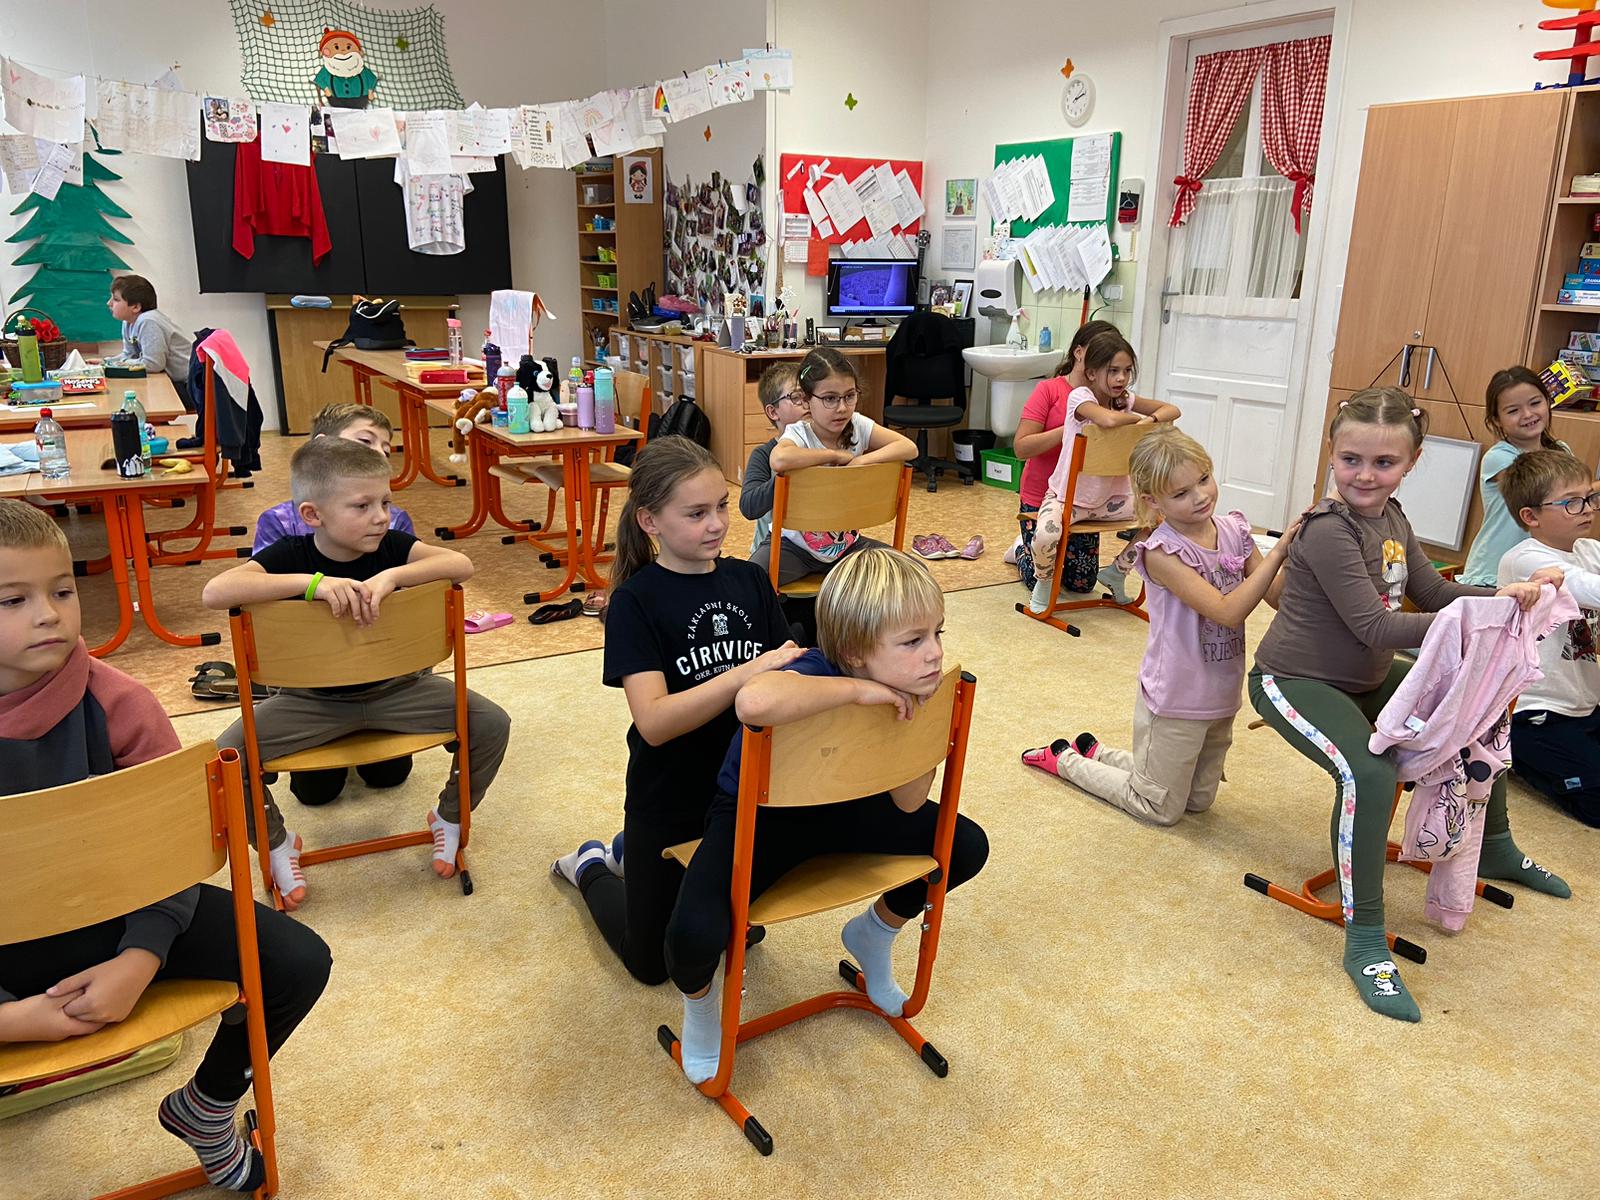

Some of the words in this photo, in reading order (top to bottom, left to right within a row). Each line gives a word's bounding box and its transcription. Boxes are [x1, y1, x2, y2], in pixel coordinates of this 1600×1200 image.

[687, 601, 722, 640] ZÁKLADNÍ
[676, 640, 763, 676] CÍRKVICE
[694, 669, 713, 681] OKR.
